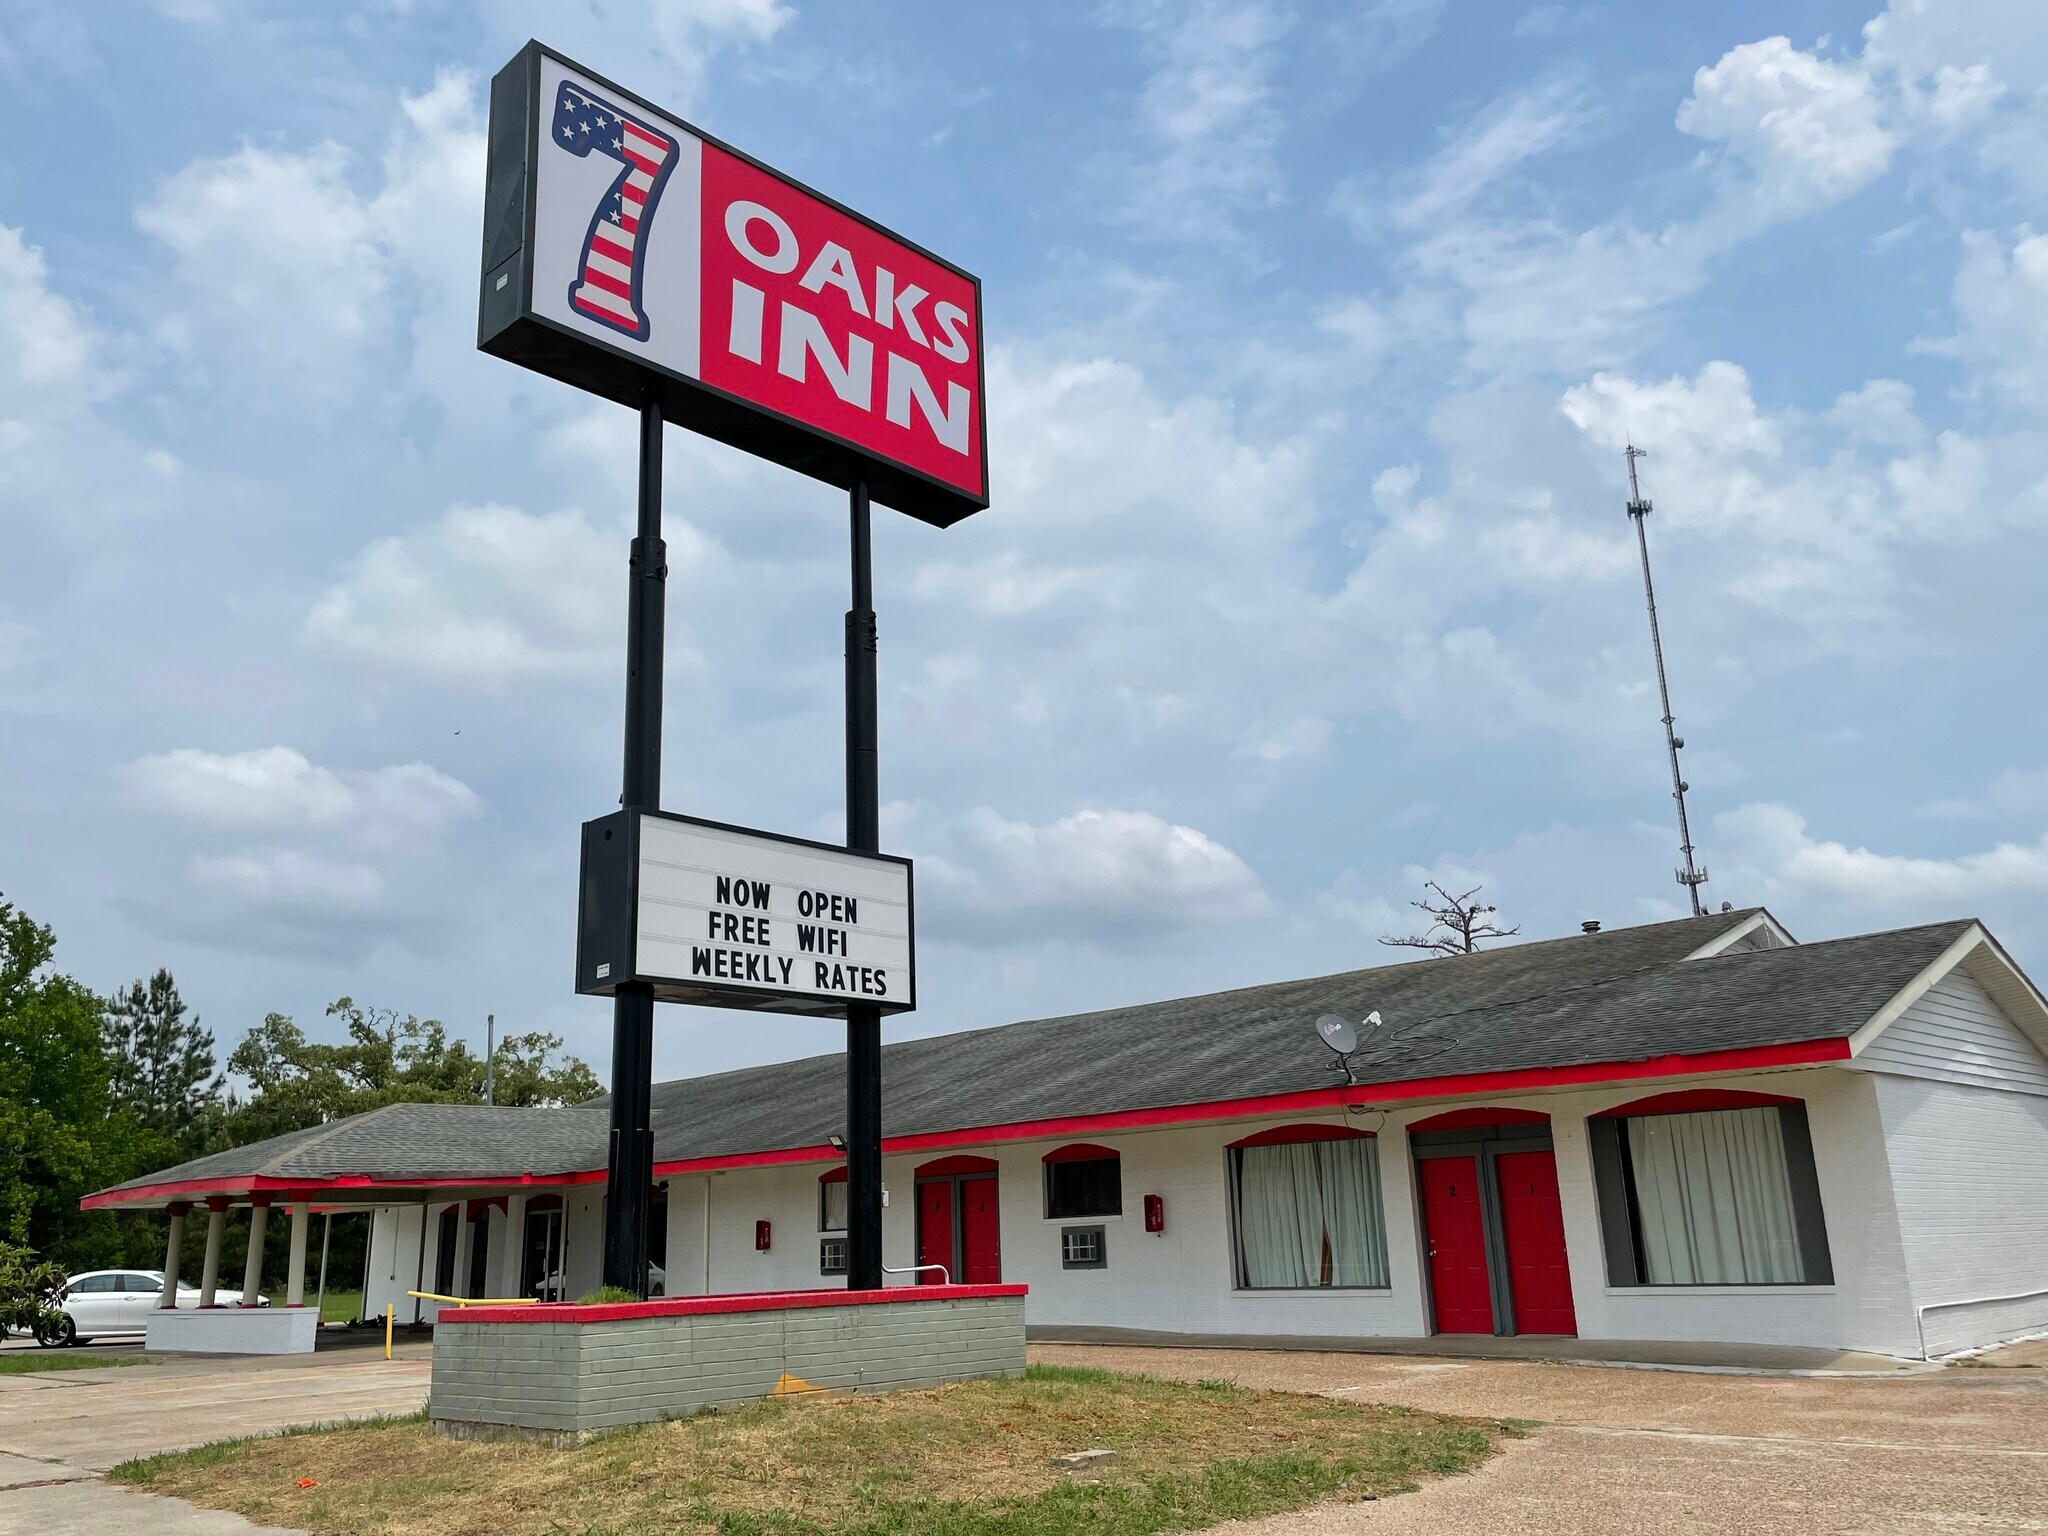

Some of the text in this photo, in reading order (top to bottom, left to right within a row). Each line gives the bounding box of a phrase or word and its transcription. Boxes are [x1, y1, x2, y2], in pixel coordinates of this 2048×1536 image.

[552, 80, 680, 342] 7
[724, 200, 970, 365] OAKS
[728, 278, 971, 457] INN
[716, 876, 857, 924] NOW OPEN
[709, 911, 847, 957] FREE WIFI
[692, 947, 887, 996] WEEKLY RATES
[1449, 1184, 1456, 1198] 2
